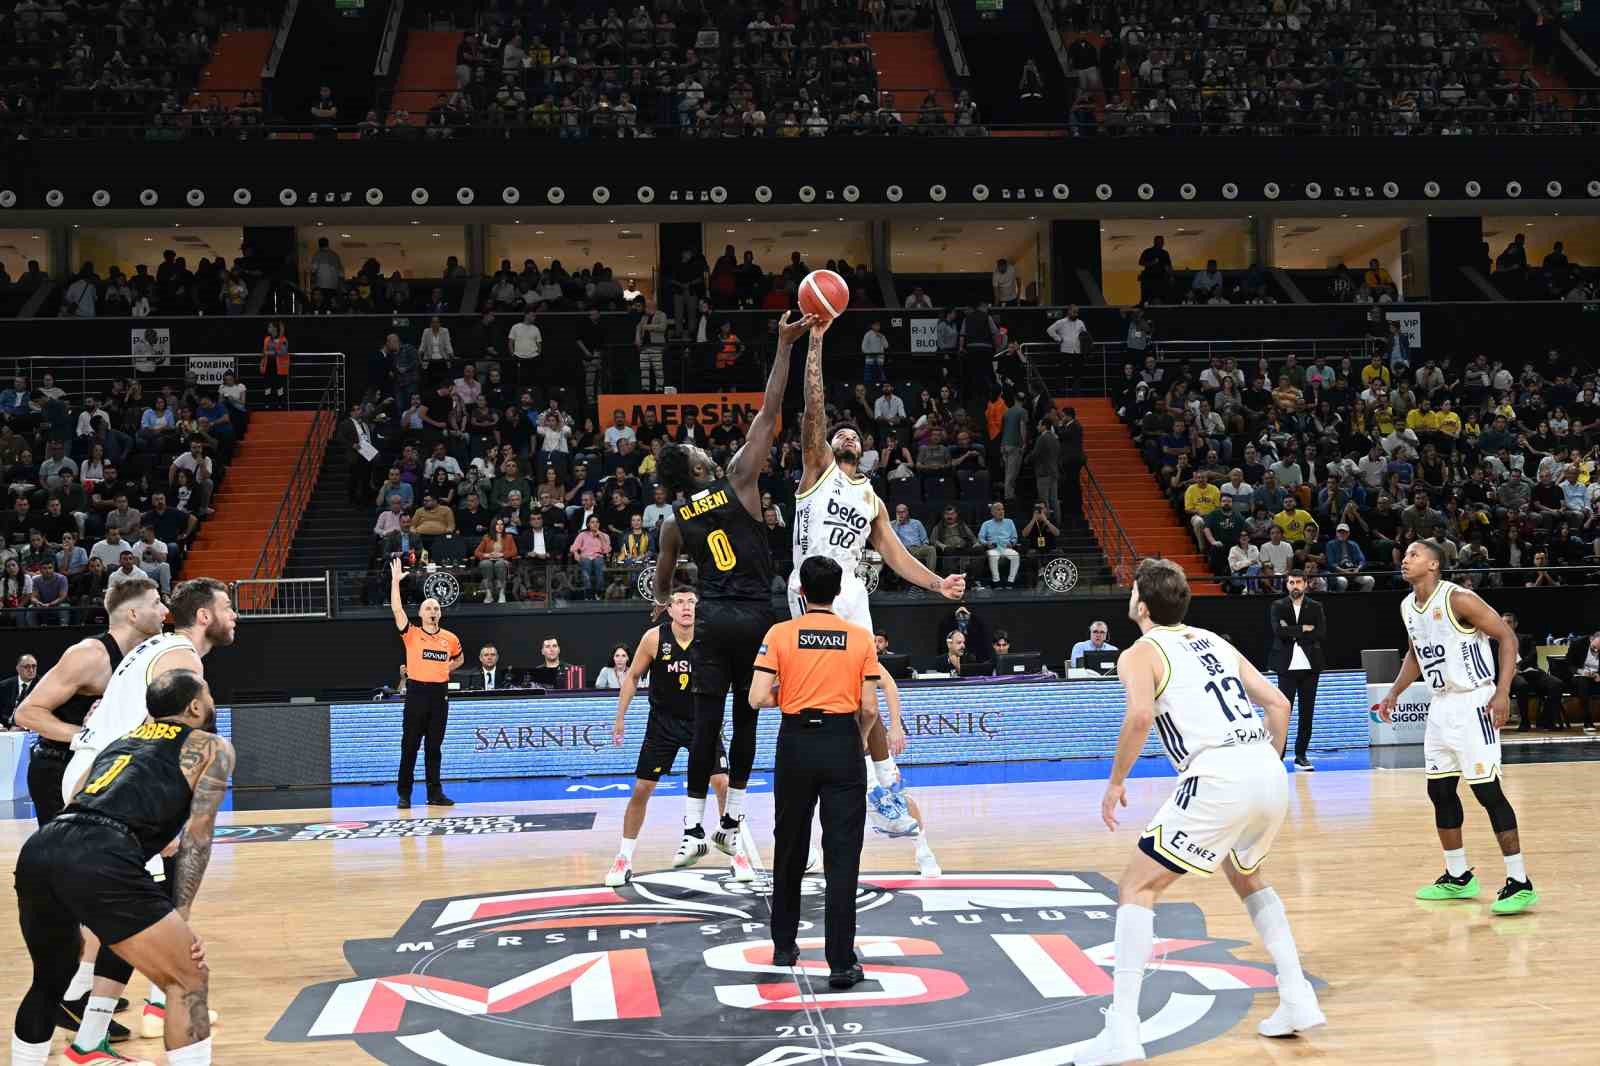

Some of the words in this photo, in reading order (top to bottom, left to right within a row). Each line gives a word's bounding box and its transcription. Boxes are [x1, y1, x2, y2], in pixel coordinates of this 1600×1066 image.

[679, 490, 729, 521] OLASENI
[827, 498, 868, 530] beko
[707, 529, 736, 571] 0
[667, 660, 692, 673] MS
[679, 673, 689, 690] 9
[1204, 676, 1252, 722] 13
[474, 723, 608, 753] SARNIÇ
[1186, 843, 1217, 861] ENEZ
[396, 928, 648, 952] MERSİN
[775, 1022, 863, 1038] 2019
